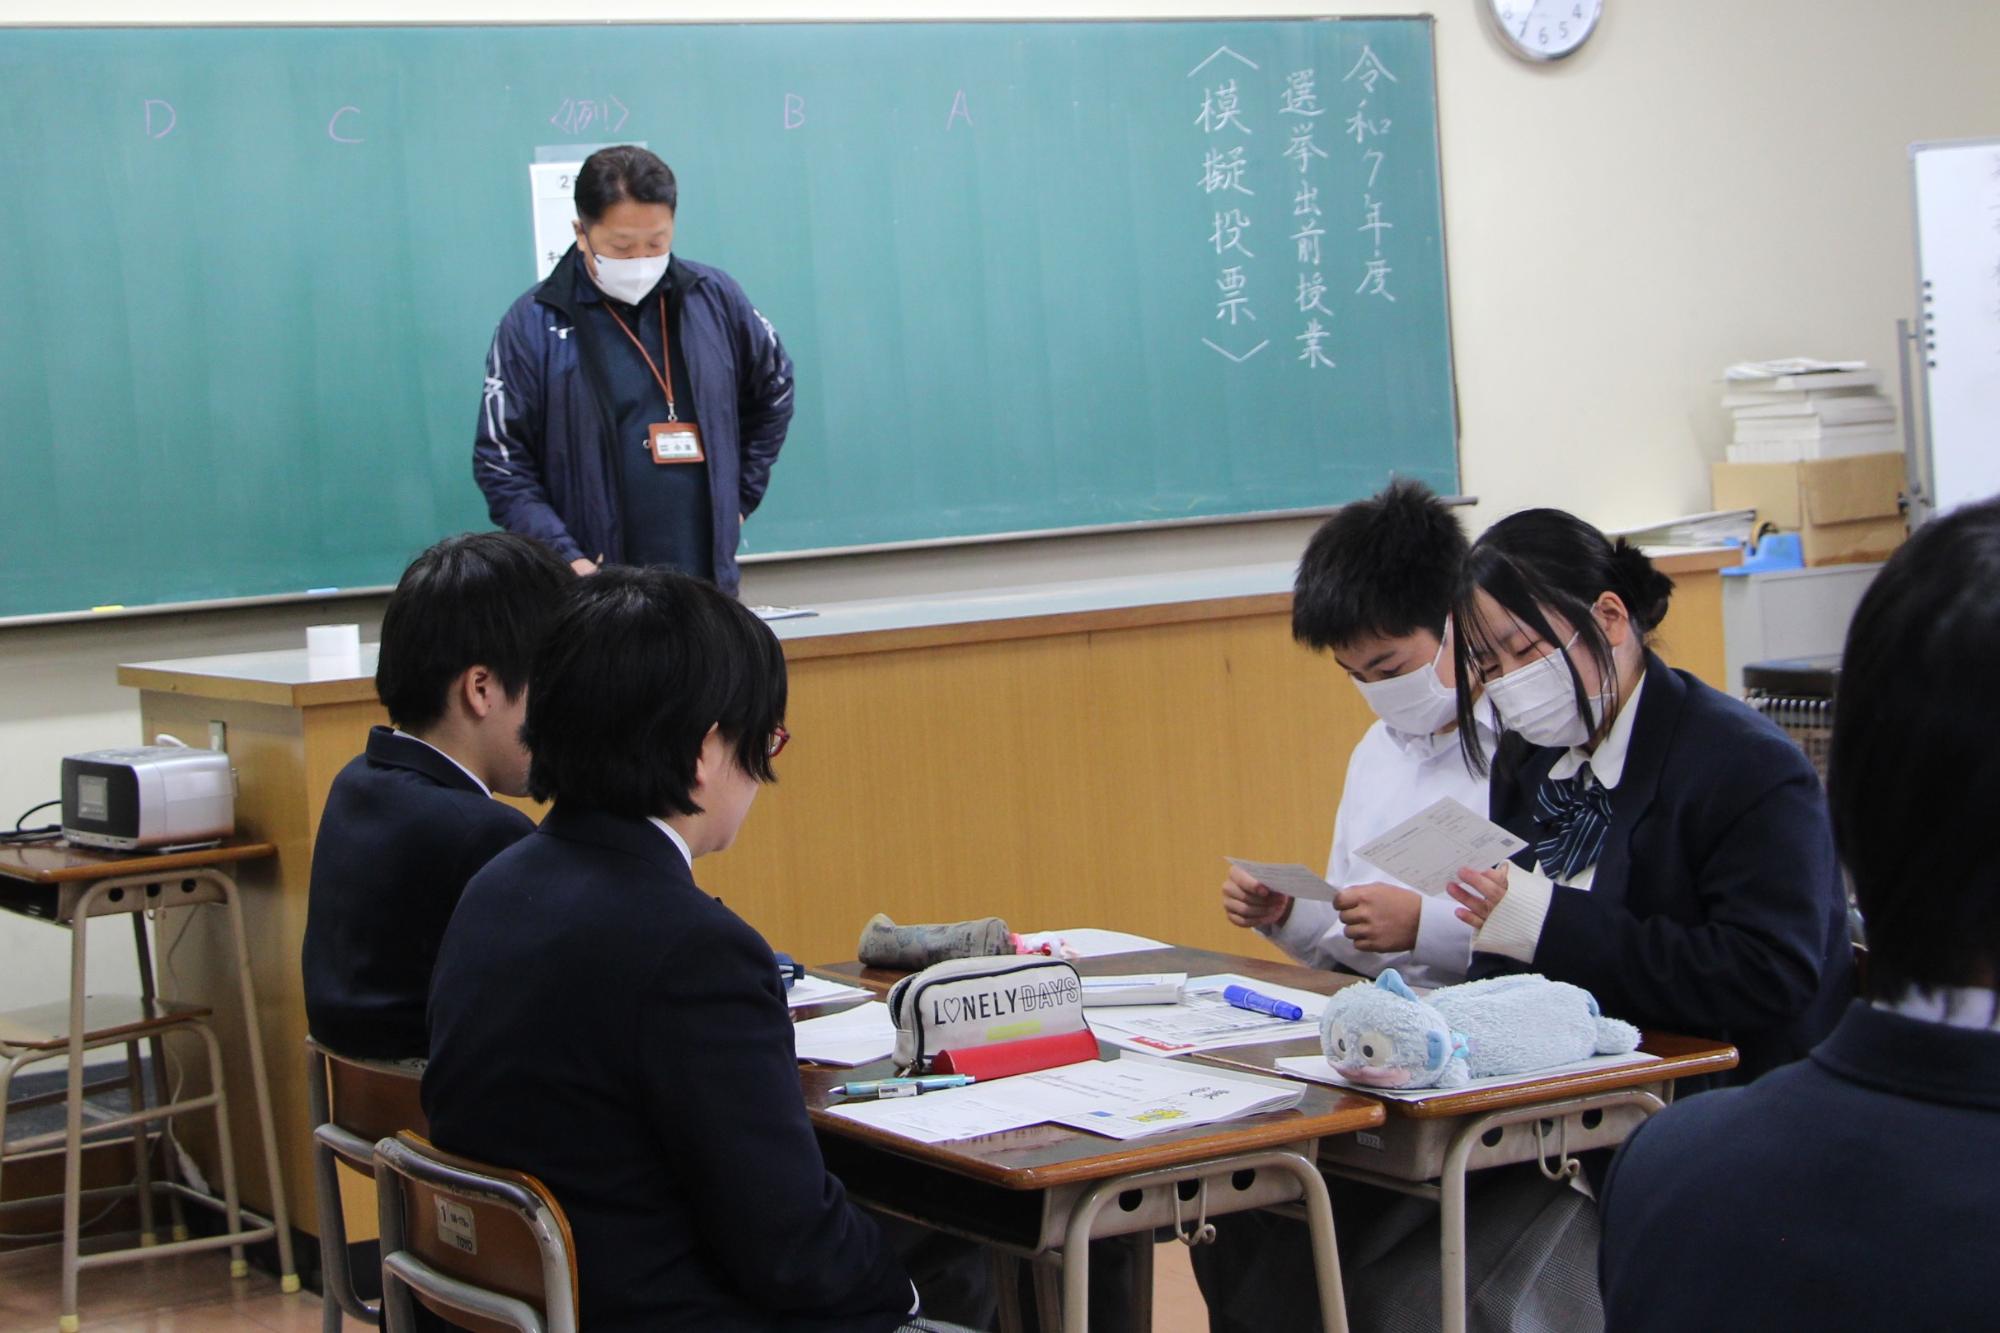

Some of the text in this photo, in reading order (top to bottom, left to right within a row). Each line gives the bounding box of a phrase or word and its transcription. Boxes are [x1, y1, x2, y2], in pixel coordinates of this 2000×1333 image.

[1558, 20, 1568, 39] 5
[1572, 4, 1582, 19] 4
[1538, 26, 1549, 45] 6
[144, 99, 177, 139] D
[328, 105, 366, 143] C
[783, 93, 806, 130] B
[946, 89, 974, 131] A
[1342, 44, 1398, 302] 令和7年度
[1278, 67, 1337, 368] 選挙出前授業
[1020, 976, 1079, 1013] DAYS
